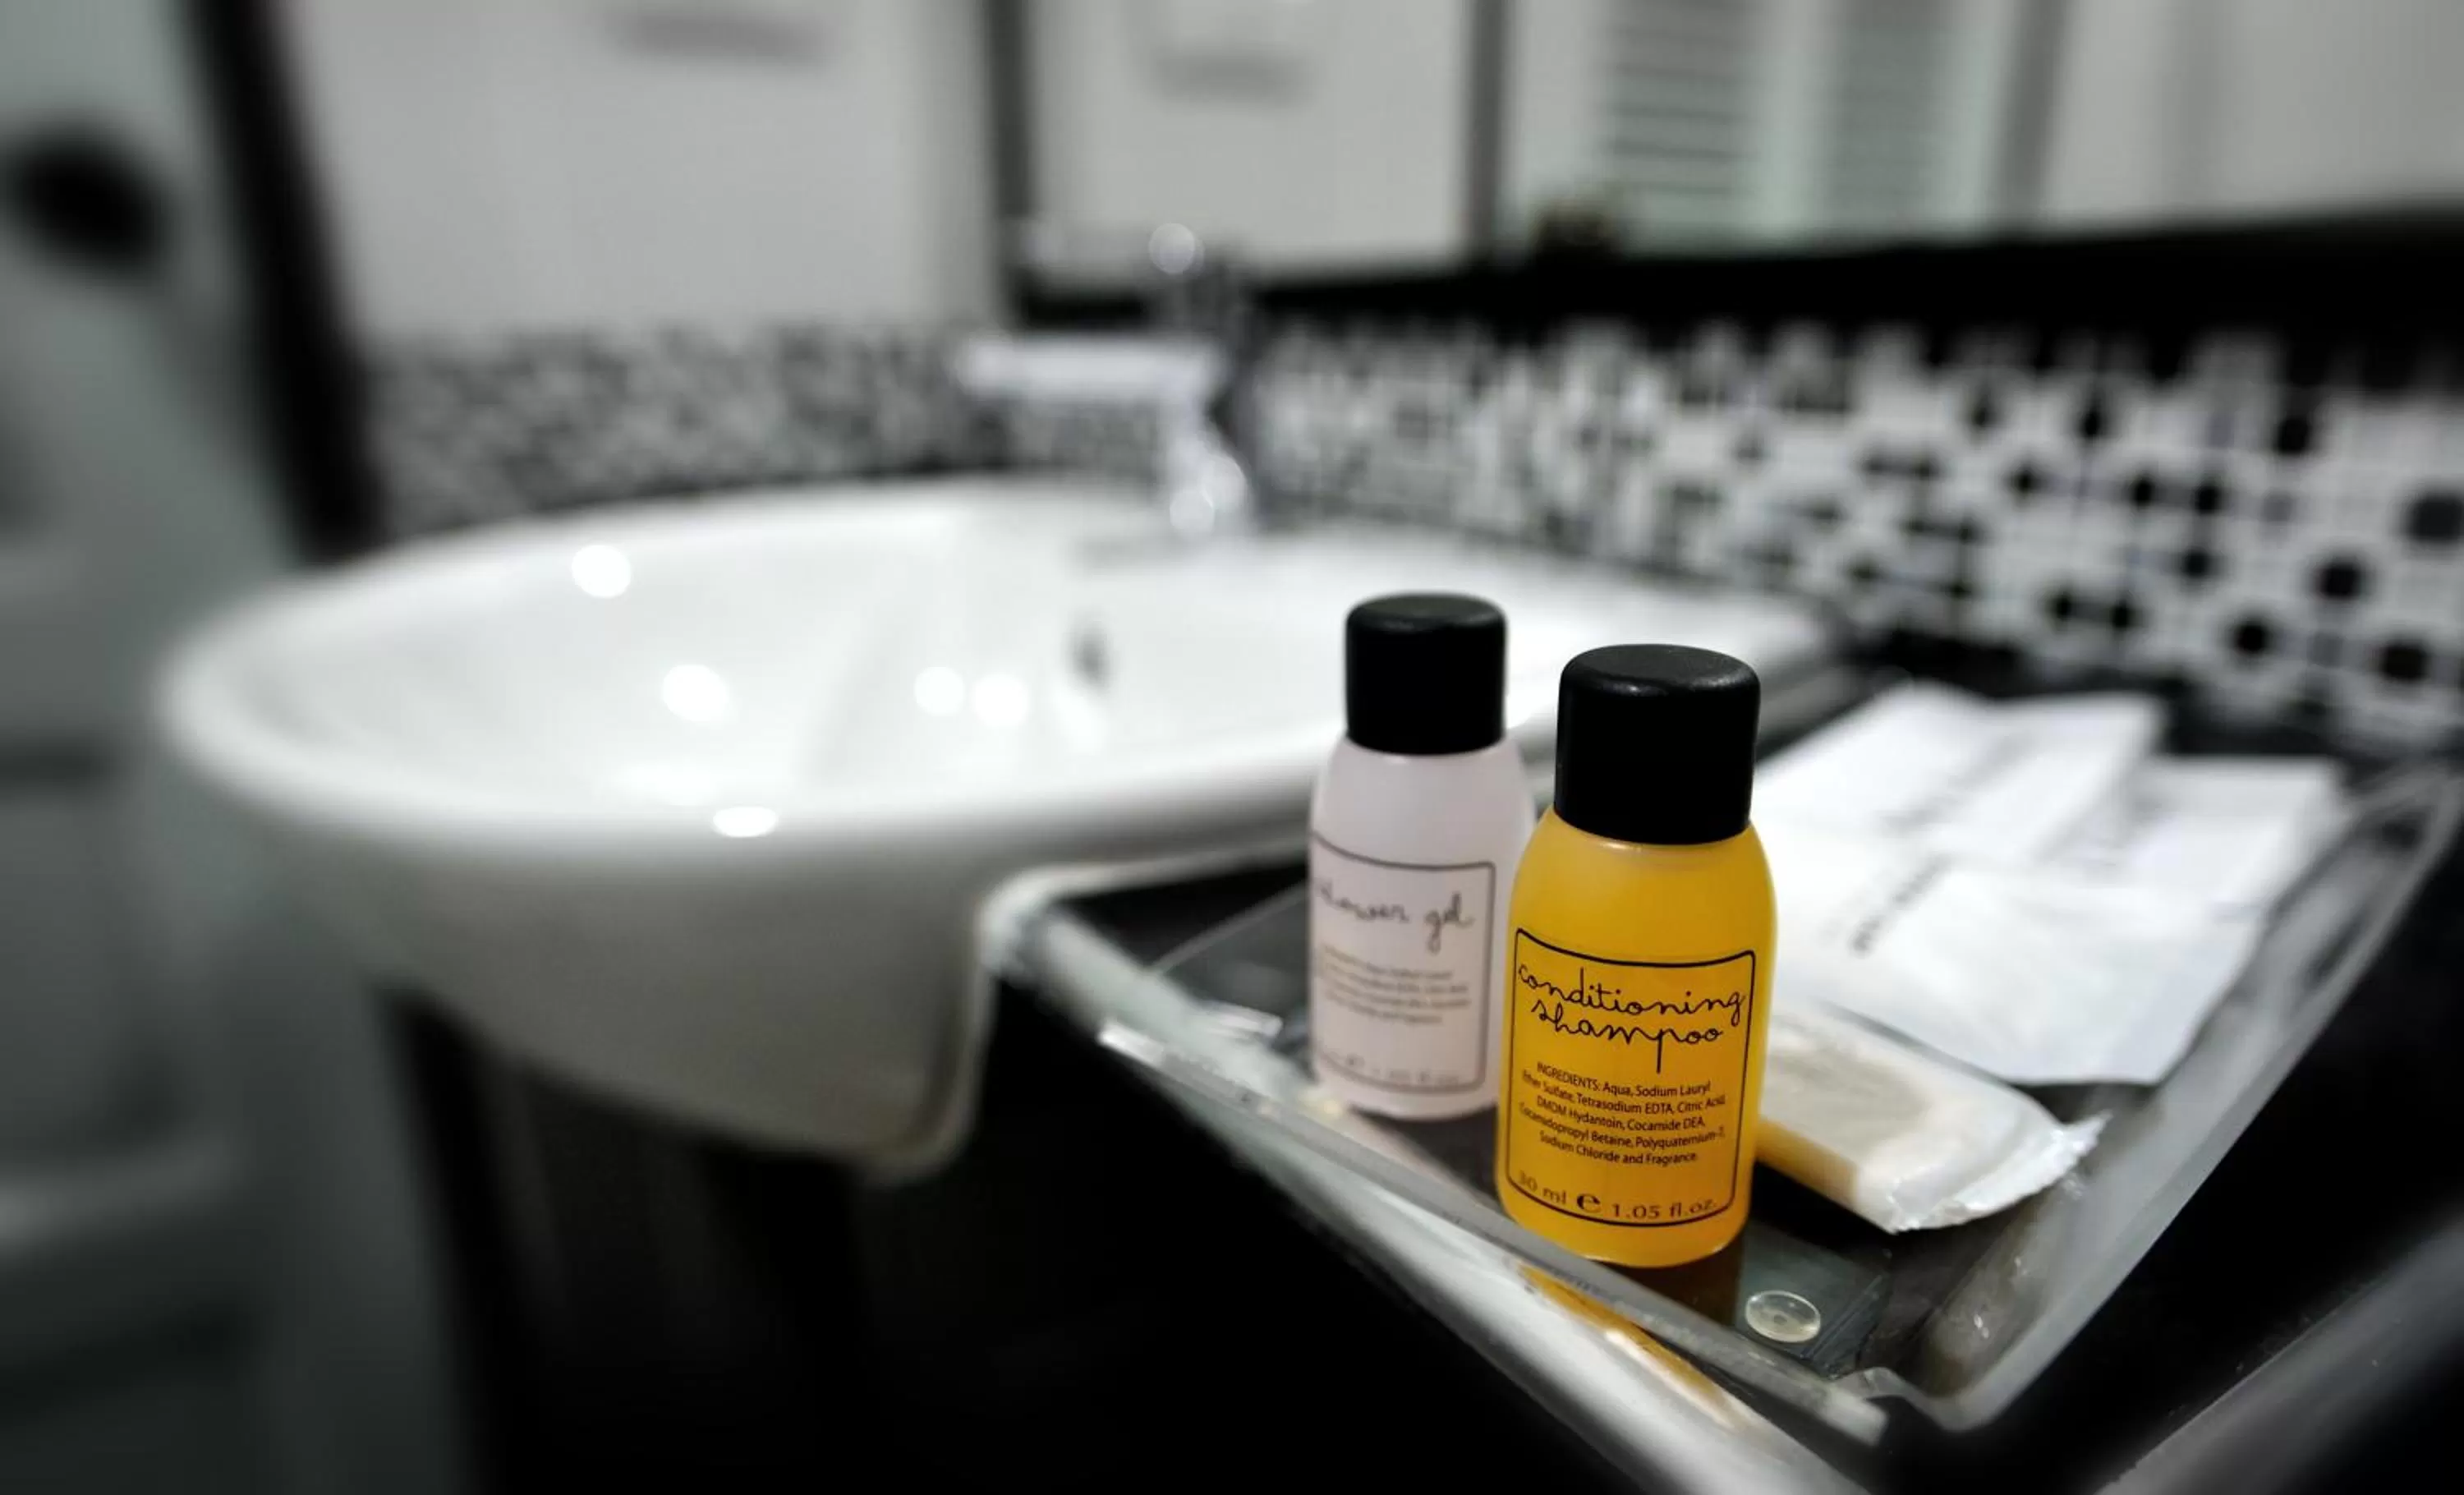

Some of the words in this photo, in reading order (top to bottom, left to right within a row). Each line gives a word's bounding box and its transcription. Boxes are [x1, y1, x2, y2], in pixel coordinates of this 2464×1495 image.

[1518, 964, 1746, 1027] conditioning
[1531, 999, 1724, 1074] shampoo
[1537, 1060, 1600, 1092] INGREDIENTS:
[1636, 1083, 1677, 1097] Sodium
[1680, 1079, 1711, 1097] Lauryl
[1537, 1095, 1567, 1116] DMDM
[1569, 1109, 1625, 1131] Hydantoin,
[1627, 1119, 1680, 1131] Cocamide
[1576, 1092, 1642, 1114] Tetrasodium
[1676, 1102, 1703, 1114] Citric
[1540, 1130, 1574, 1152] Sodium
[1576, 1143, 1620, 1163] Chloride
[1622, 1153, 1643, 1165] and
[1519, 1170, 1538, 1192] 30
[1542, 1187, 1566, 1206] ml
[1611, 1203, 1661, 1219] 1.05
